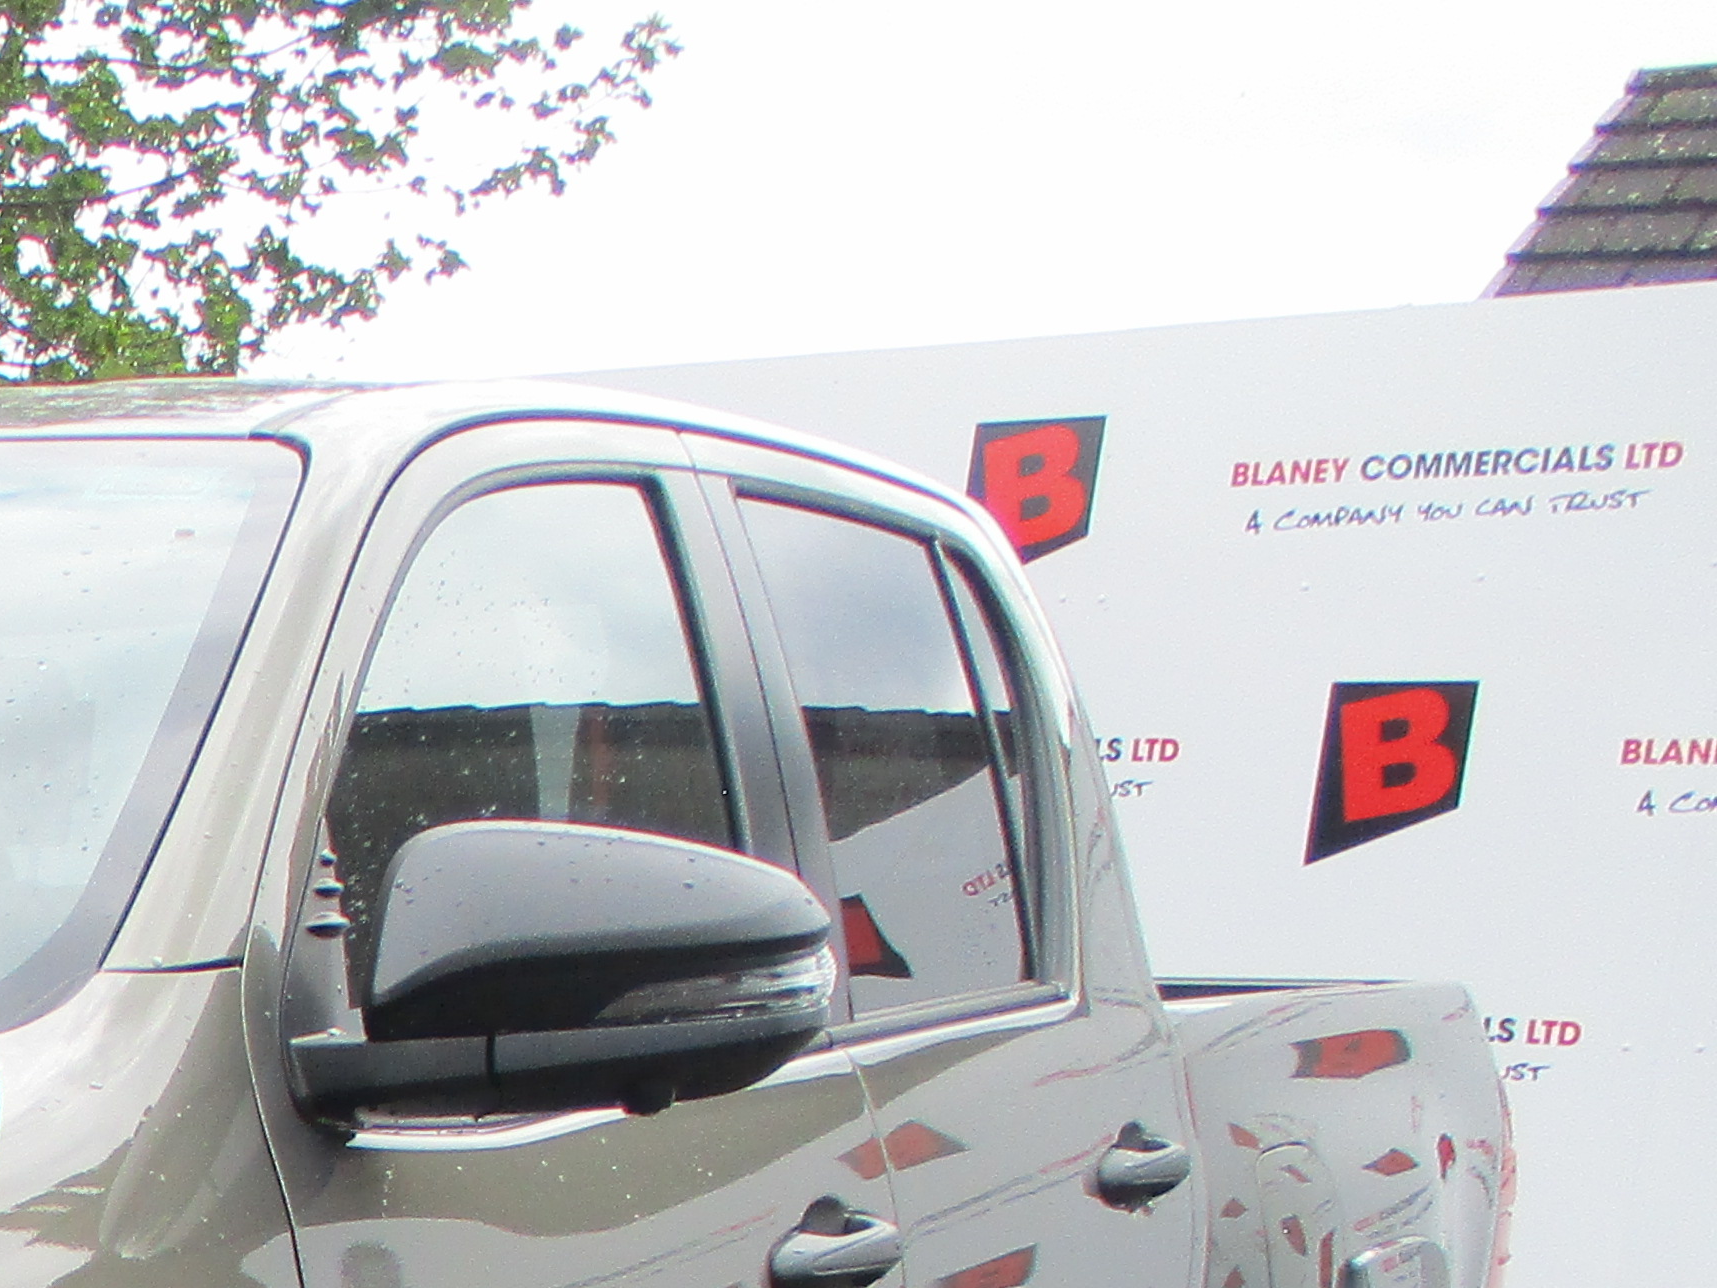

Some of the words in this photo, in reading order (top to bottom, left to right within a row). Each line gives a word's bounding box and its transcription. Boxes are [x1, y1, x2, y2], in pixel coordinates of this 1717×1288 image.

[983, 423, 1087, 548] B
[1230, 456, 1350, 487] BLANEY
[1360, 443, 1615, 482] COMMERCIALS
[1623, 441, 1684, 470] LTD
[1273, 505, 1405, 532] COMPANY
[1417, 502, 1464, 522] YOU
[1475, 495, 1534, 517] CAN
[1549, 489, 1653, 514] TRUST
[1131, 738, 1180, 762] LTD
[1340, 687, 1457, 822] B
[1620, 738, 1717, 765] BLAN
[1526, 1019, 1582, 1046] LTD
